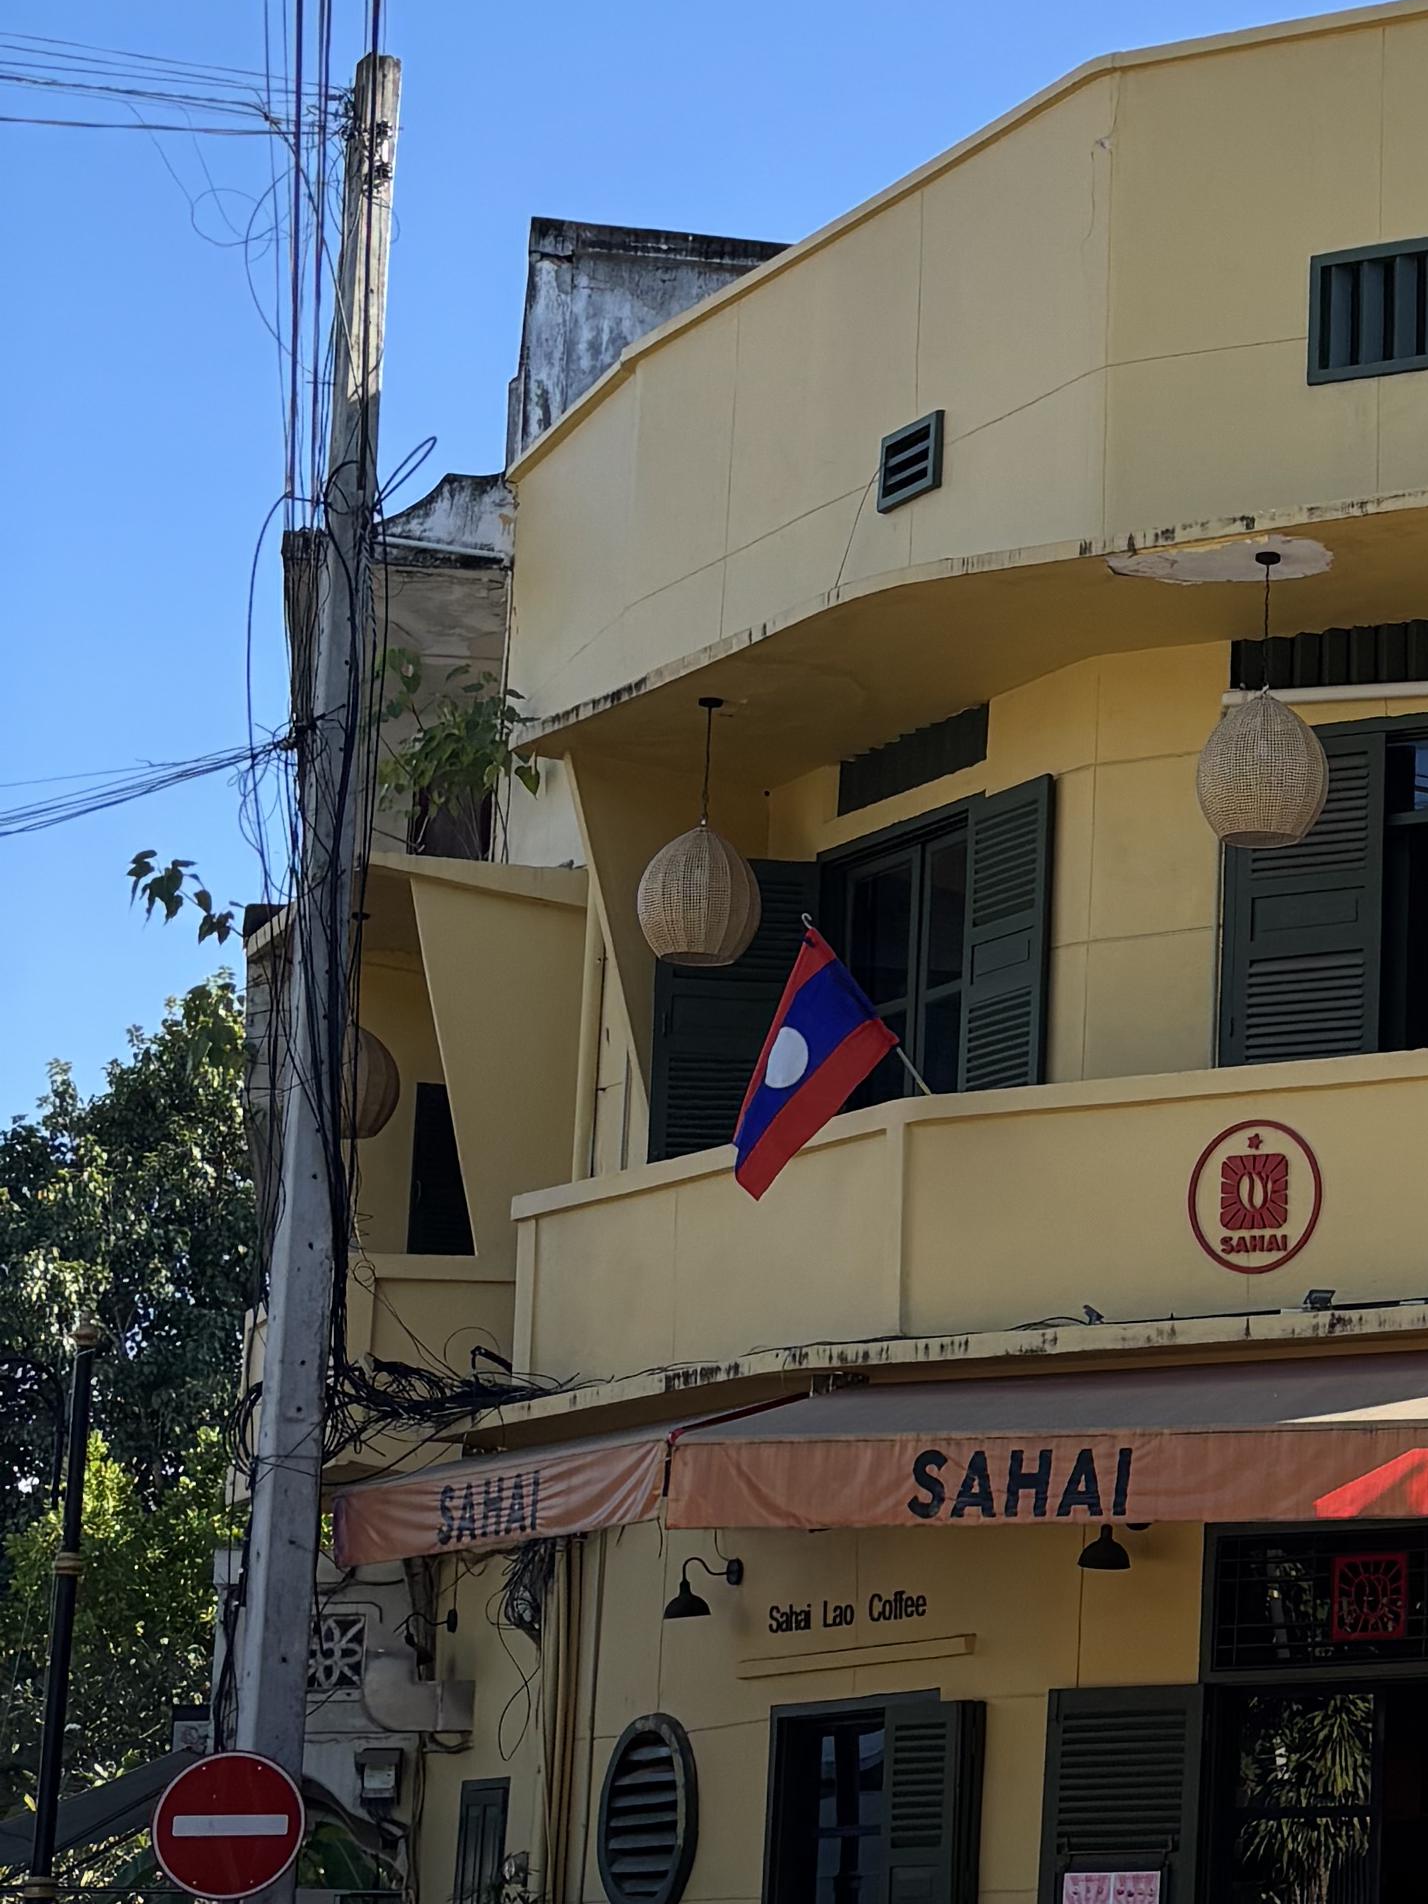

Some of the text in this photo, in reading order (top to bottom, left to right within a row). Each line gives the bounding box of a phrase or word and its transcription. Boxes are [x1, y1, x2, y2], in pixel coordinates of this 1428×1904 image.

[1220, 1234, 1289, 1255] SAHAI
[438, 1471, 541, 1546] SAHAI
[908, 1448, 1133, 1520] SAHAI
[769, 1590, 927, 1634] Sahai Lao Coffee
